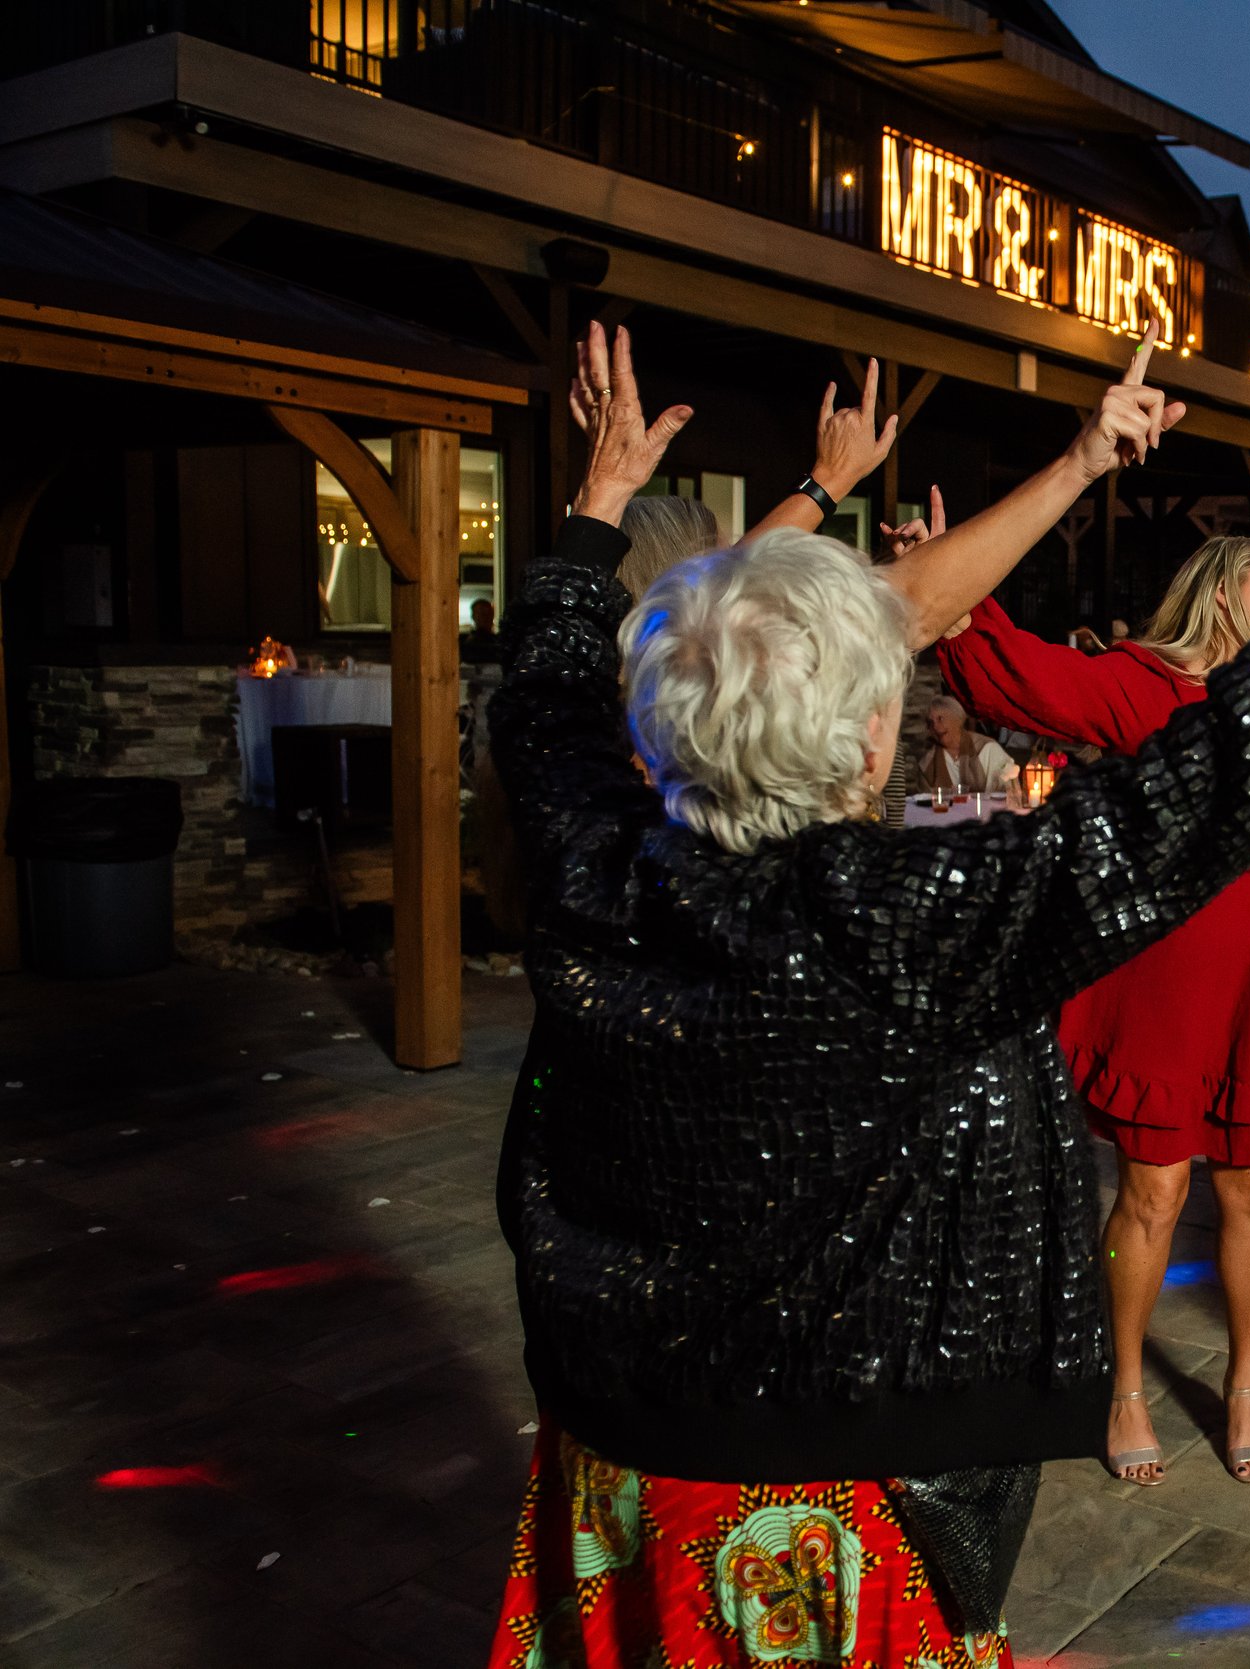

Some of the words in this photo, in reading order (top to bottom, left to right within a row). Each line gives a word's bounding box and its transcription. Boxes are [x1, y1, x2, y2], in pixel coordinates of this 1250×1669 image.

[881, 134, 982, 278] MR
[994, 186, 1045, 300] &
[1077, 220, 1177, 343] MRS
